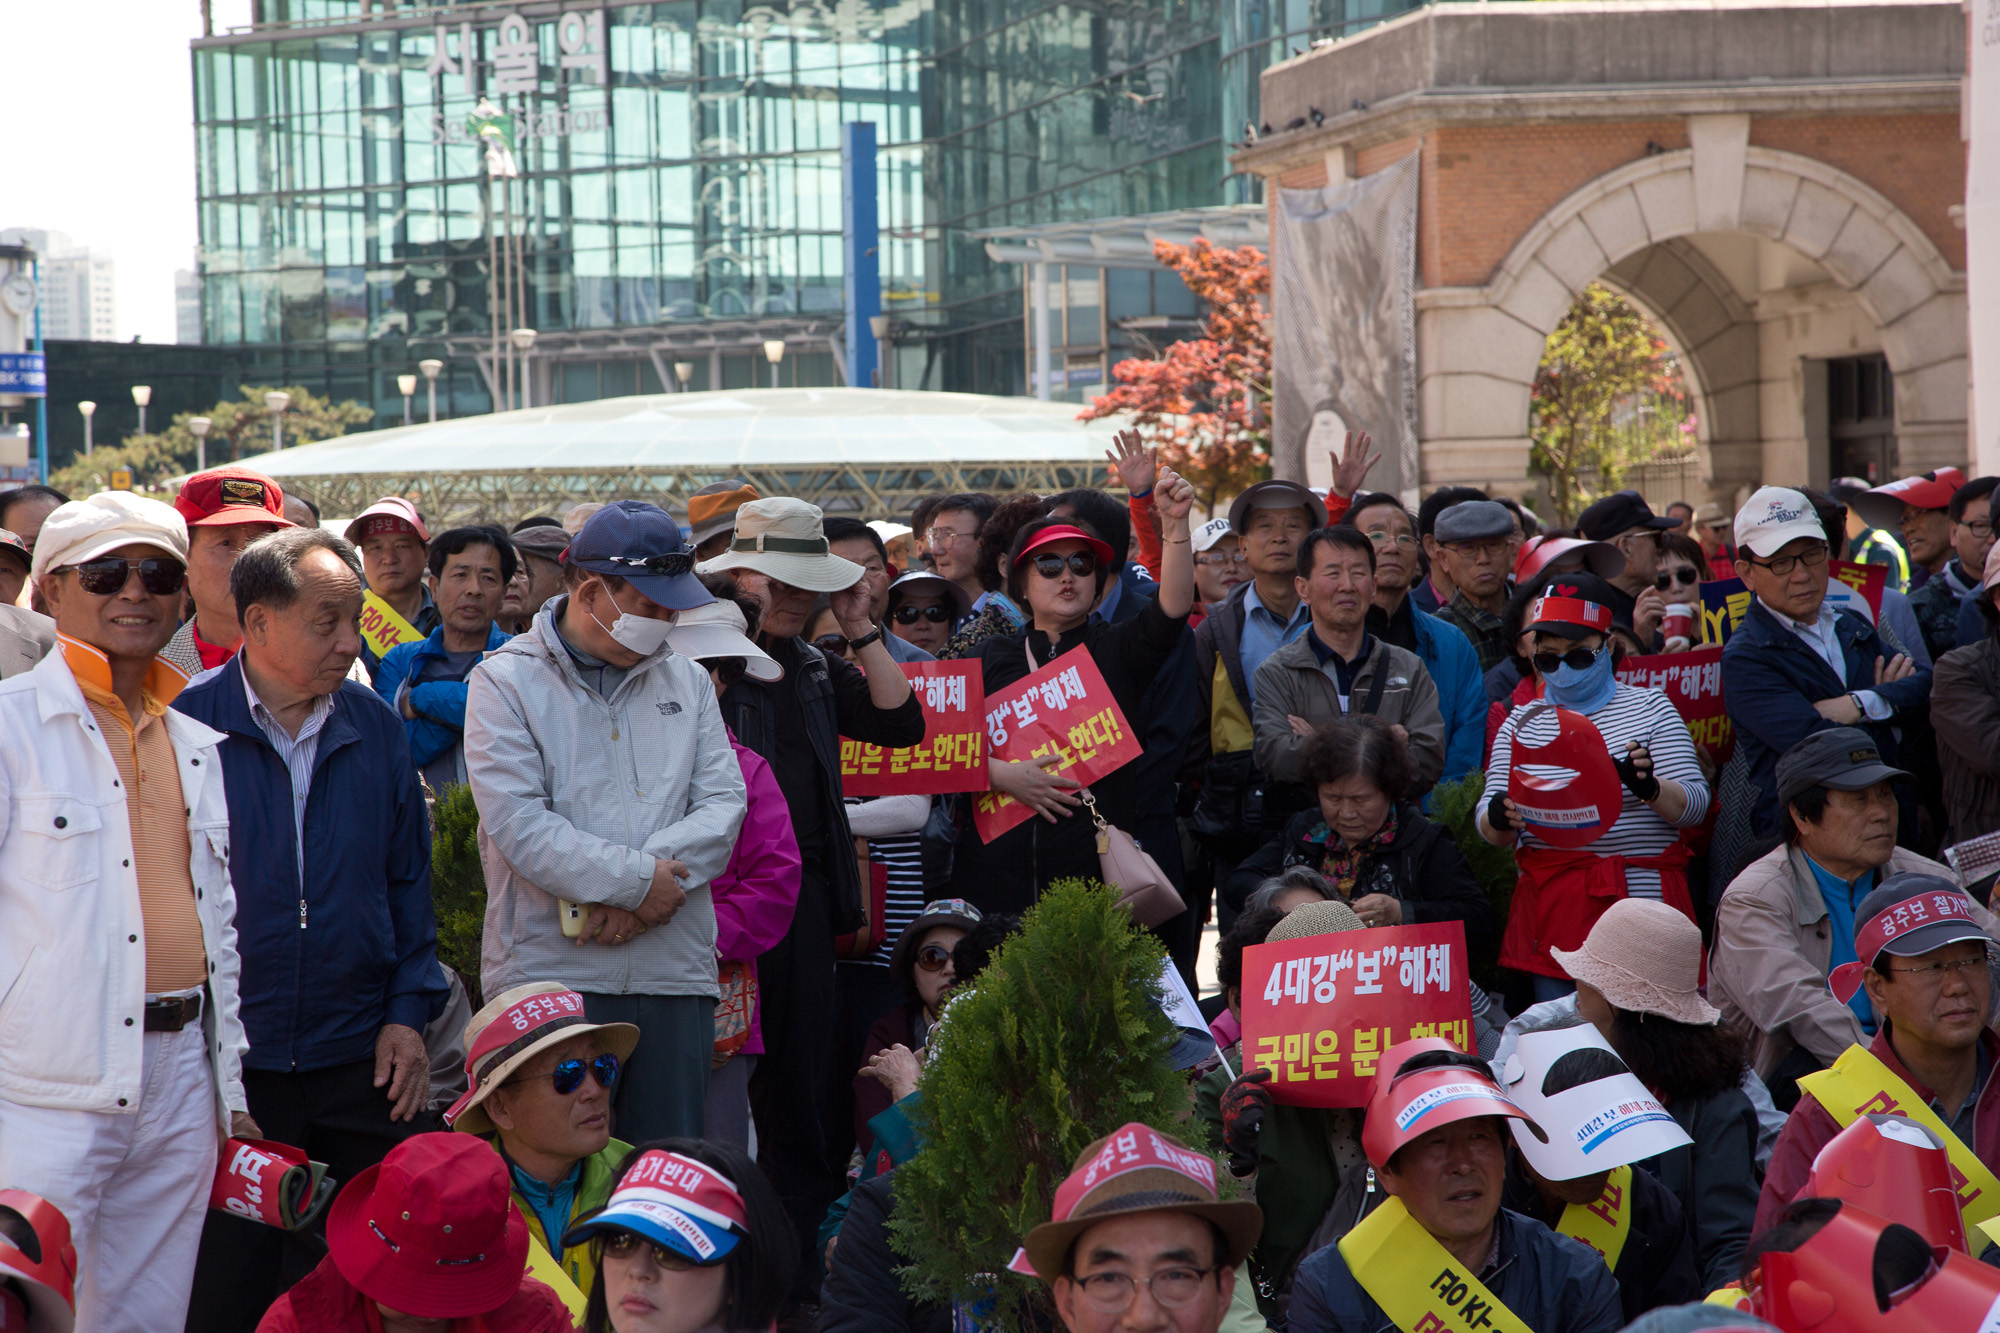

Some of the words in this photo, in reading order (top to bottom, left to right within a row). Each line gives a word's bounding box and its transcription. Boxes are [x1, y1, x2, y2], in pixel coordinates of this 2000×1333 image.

[428, 11, 606, 94] 서울역
[1880, 900, 1930, 937] 공주보
[508, 996, 560, 1031] 공주보
[1254, 1029, 1341, 1083] 국민은
[1577, 1116, 1605, 1142] 4대강
[1603, 1108, 1620, 1123] 보
[629, 1156, 705, 1194] 철거반대
[1084, 1131, 1141, 1187] 공주보
